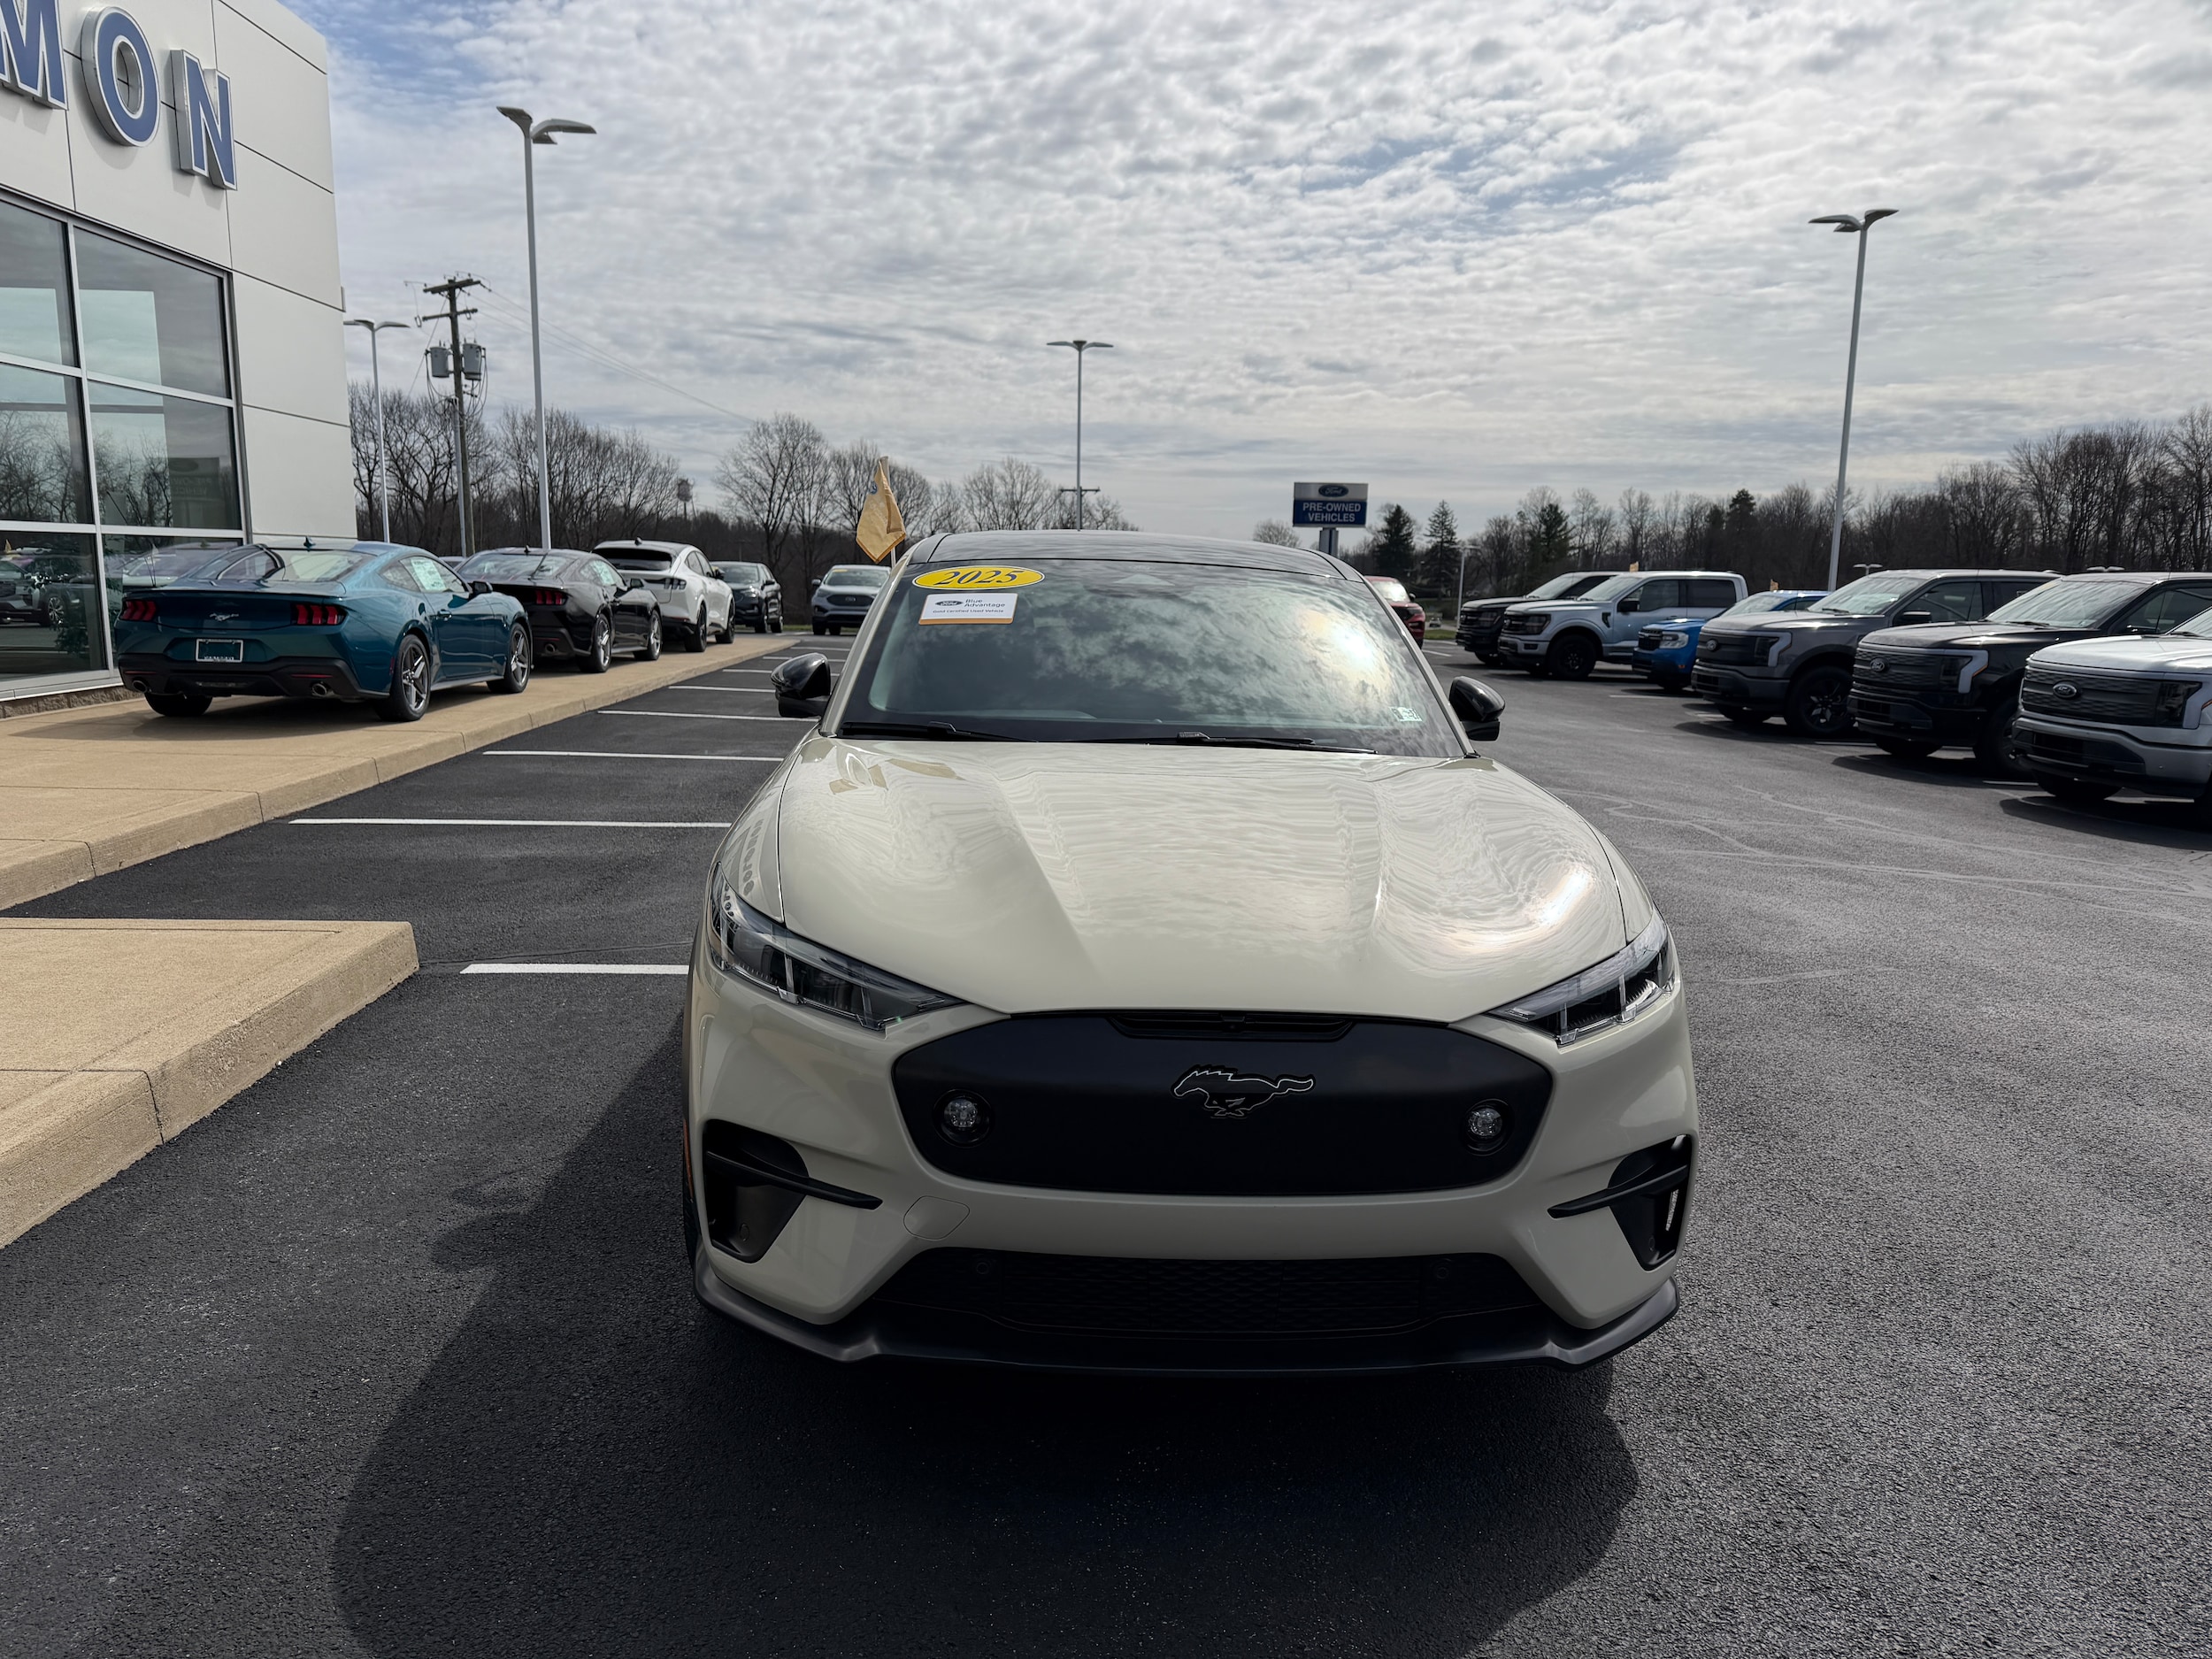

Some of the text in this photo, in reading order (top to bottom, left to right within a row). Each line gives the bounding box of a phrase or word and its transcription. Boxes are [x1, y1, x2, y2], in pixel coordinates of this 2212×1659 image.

[1302, 503, 1361, 512] PRE-OWNED
[1308, 513, 1356, 522] VEHICLES
[933, 570, 1025, 586] 2025
